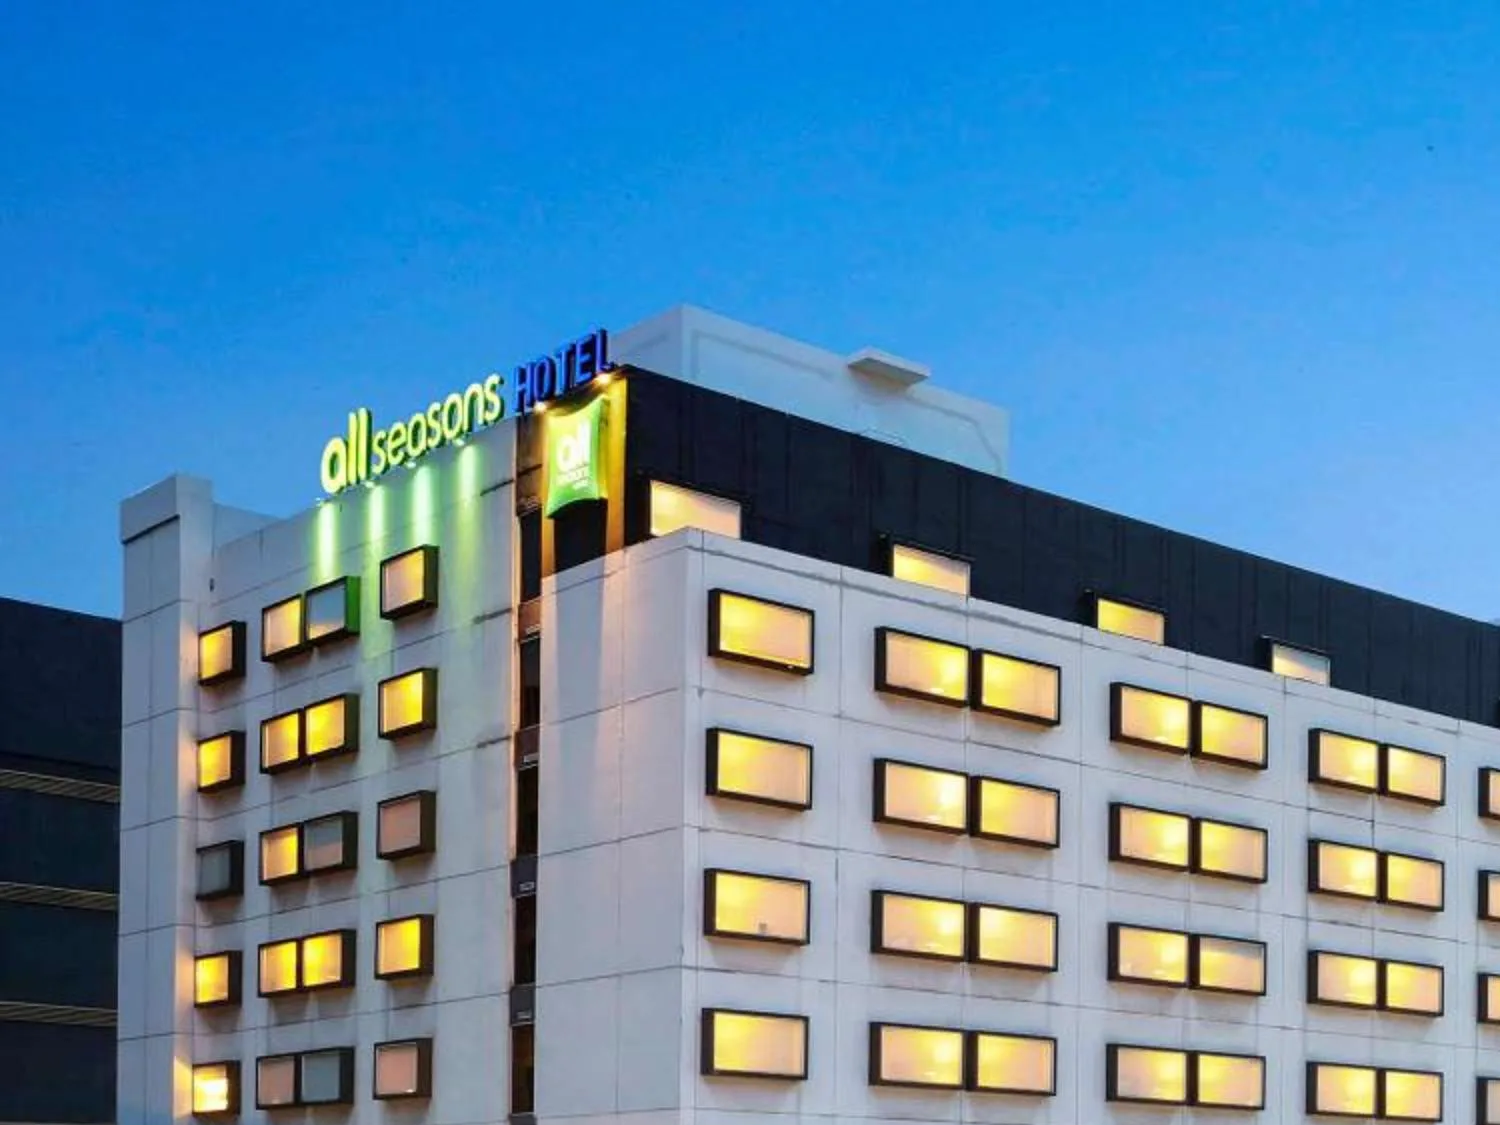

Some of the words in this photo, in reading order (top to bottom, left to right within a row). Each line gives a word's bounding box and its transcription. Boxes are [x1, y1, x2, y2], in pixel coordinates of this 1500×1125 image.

[320, 407, 370, 493] all
[372, 373, 503, 475] seasons
[514, 328, 612, 412] HOTEL
